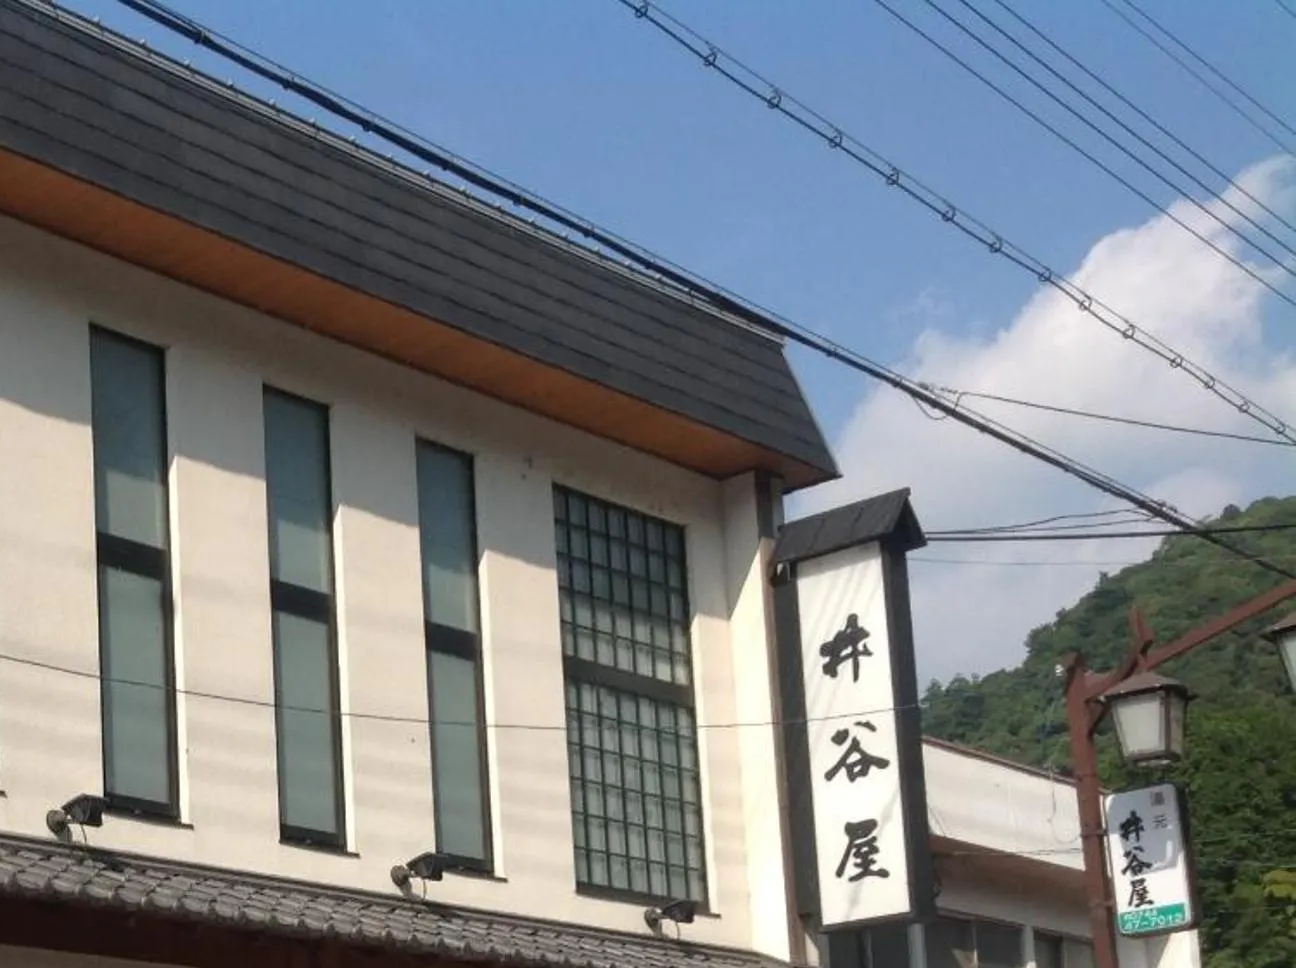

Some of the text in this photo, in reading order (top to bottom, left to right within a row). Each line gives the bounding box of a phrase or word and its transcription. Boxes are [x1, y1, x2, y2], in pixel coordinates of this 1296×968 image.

[819, 613, 890, 882] 井谷屋
[1120, 810, 1154, 907] 井谷屋
